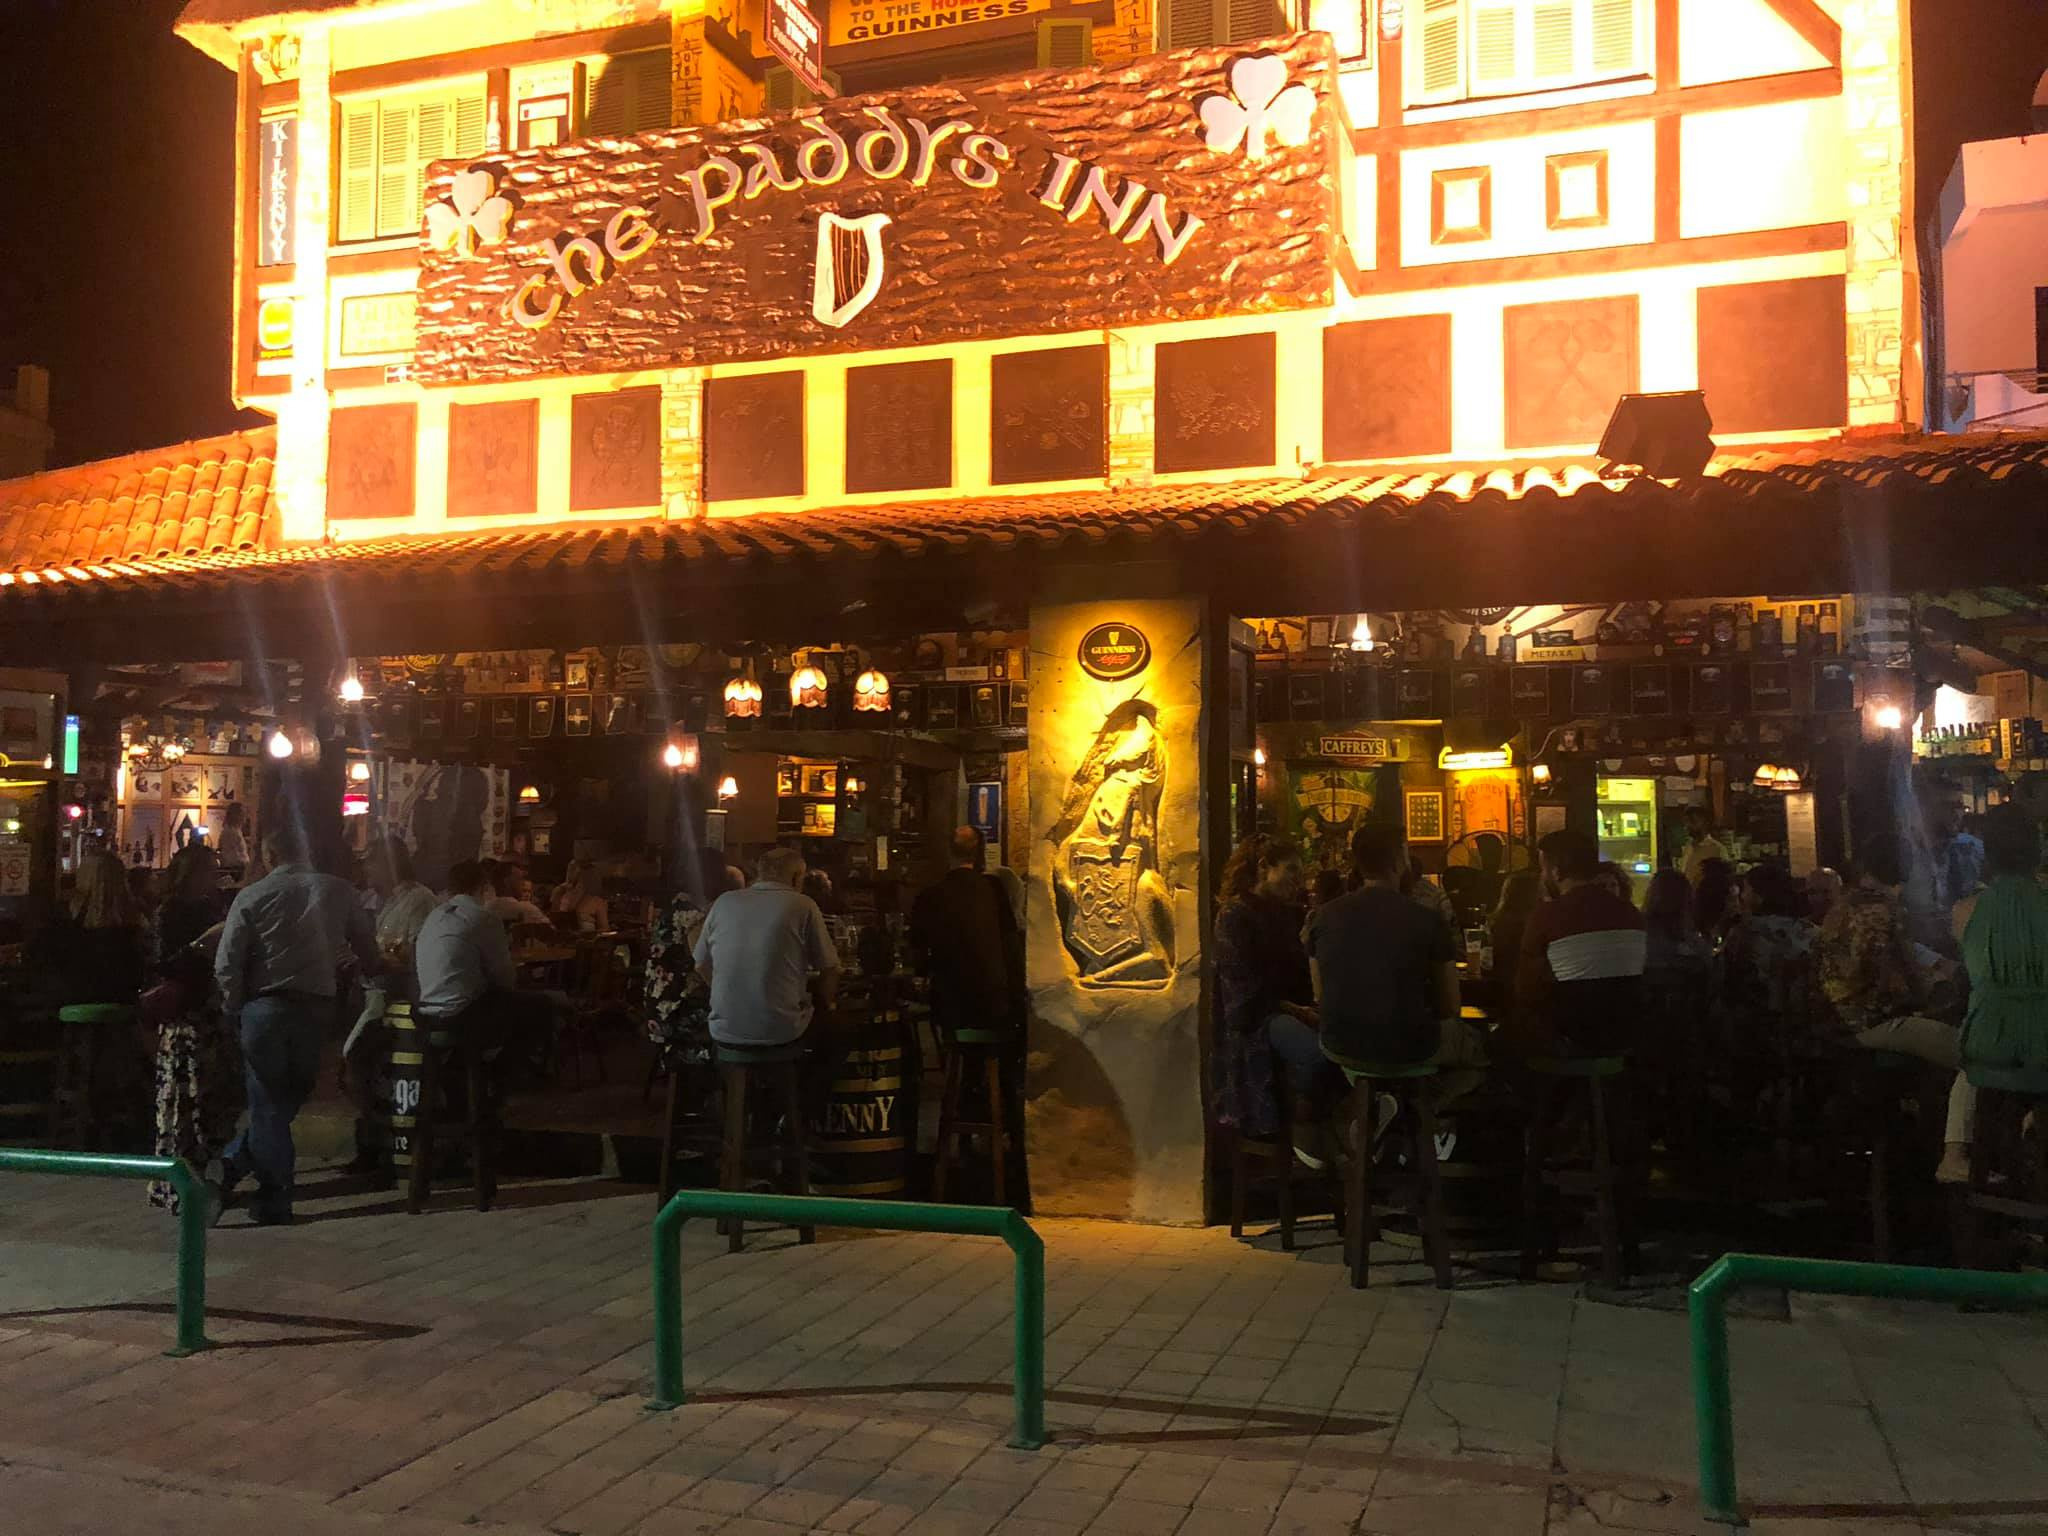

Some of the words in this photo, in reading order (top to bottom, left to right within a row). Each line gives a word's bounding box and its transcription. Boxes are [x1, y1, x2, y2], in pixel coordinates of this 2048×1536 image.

[847, 0, 1029, 40] GUINNESS
[849, 11, 875, 24] TO
[884, 2, 921, 18] THE
[1038, 151, 1206, 265] INN
[1091, 645, 1136, 654] GUINNESS
[1530, 650, 1574, 658] METAXA
